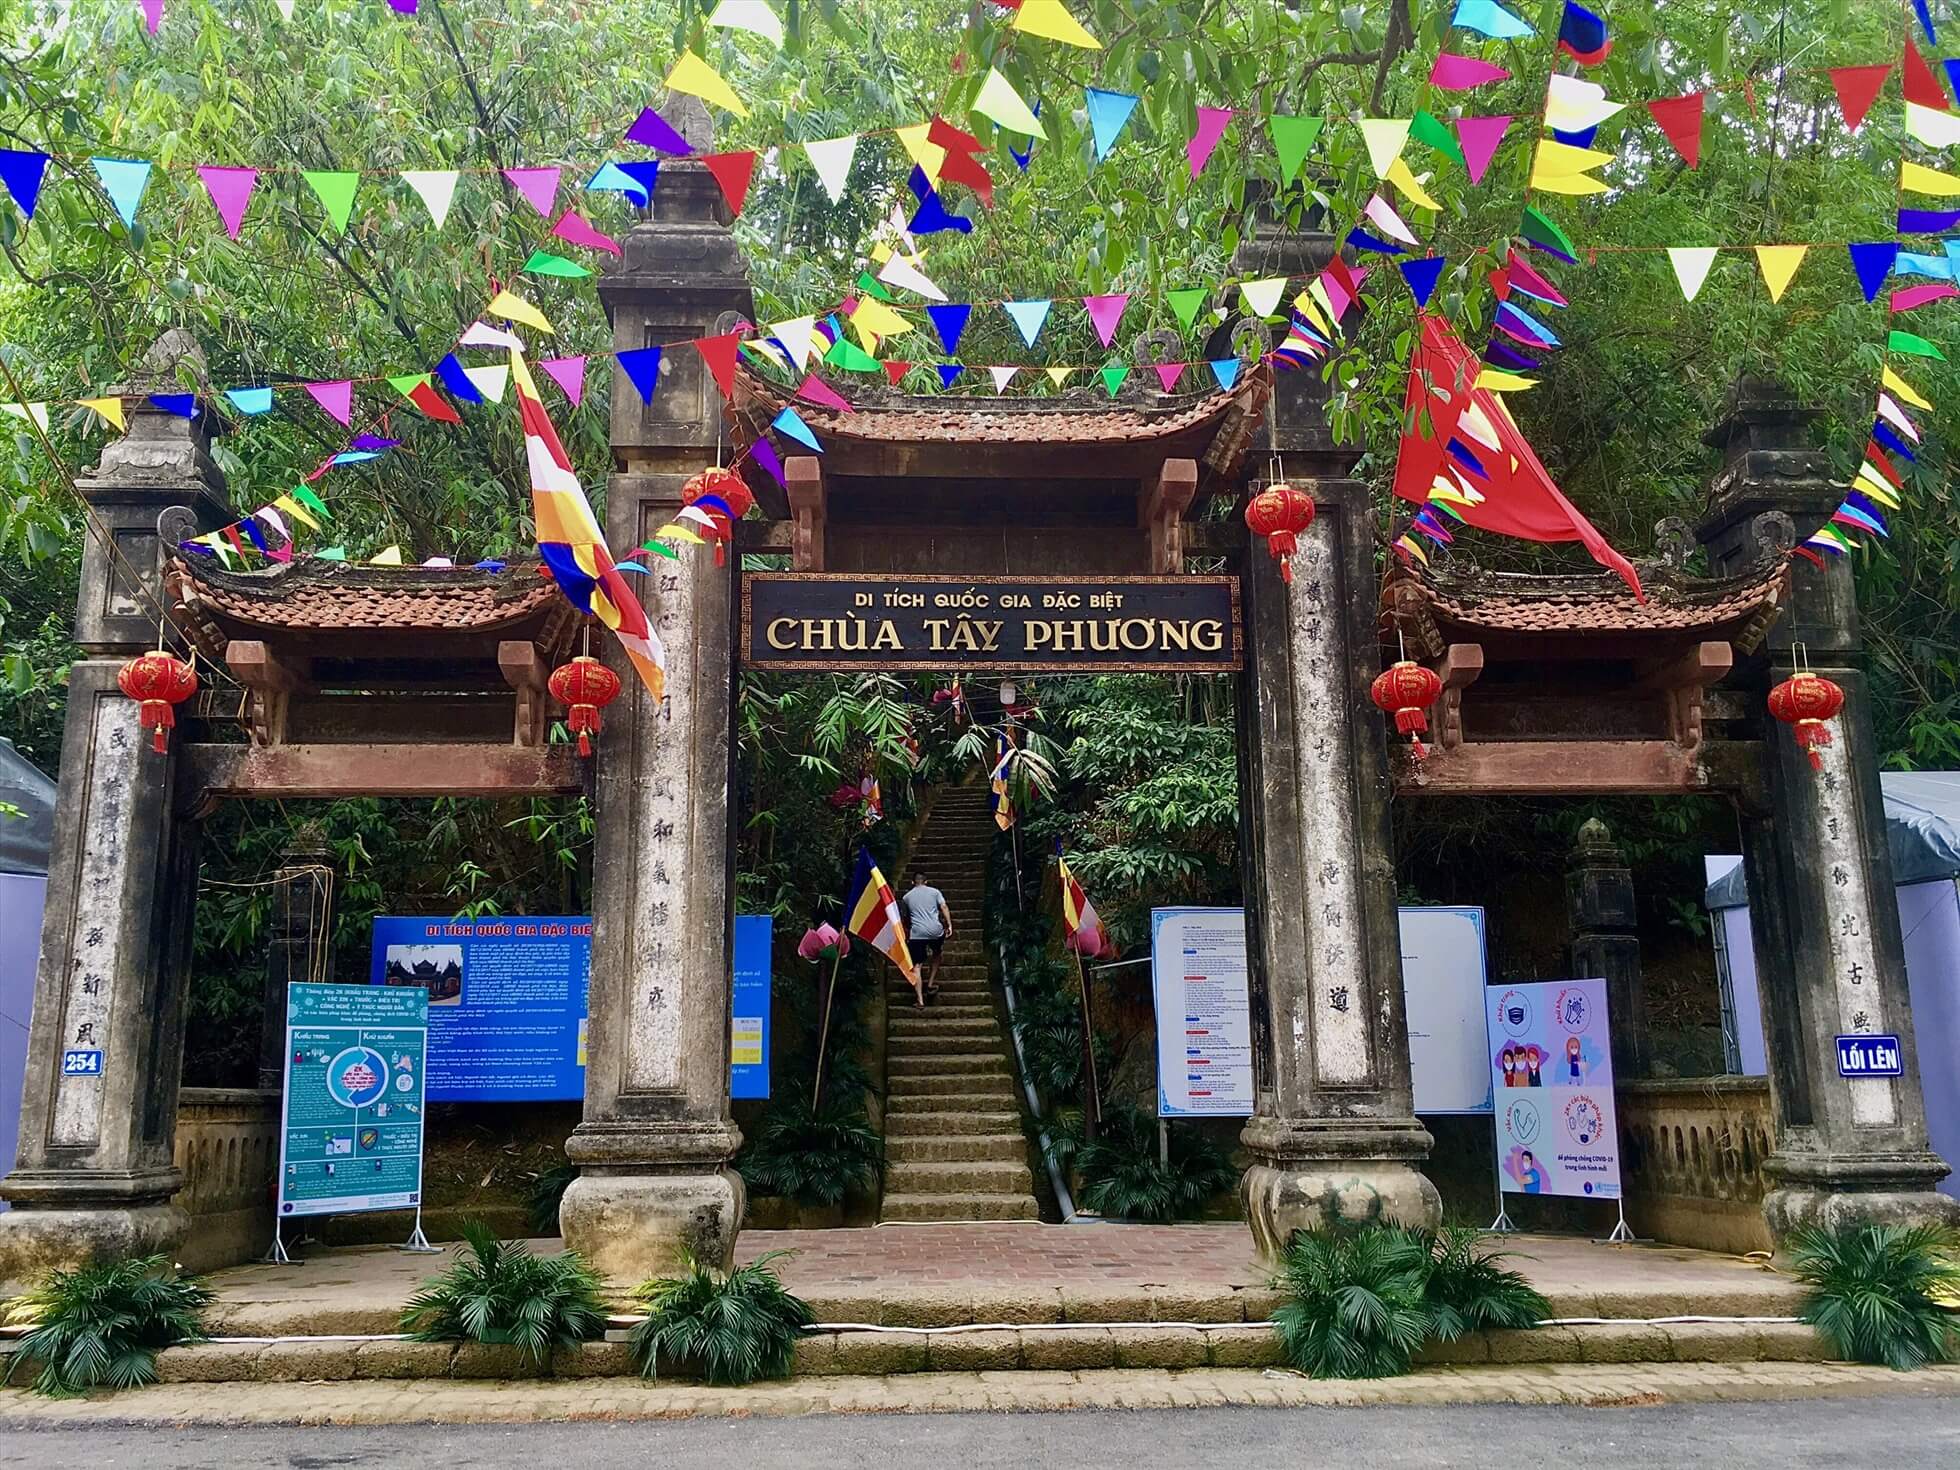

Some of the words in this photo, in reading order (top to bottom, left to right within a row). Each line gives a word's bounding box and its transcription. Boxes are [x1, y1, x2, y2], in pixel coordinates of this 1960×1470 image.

[855, 592, 873, 608] DI
[883, 588, 925, 608] TÍCH
[934, 587, 989, 609] QUỐC
[1000, 593, 1032, 608] GIA
[1042, 590, 1081, 612] ĐẶC
[1090, 590, 1124, 612] BIỆT
[767, 610, 904, 651] CHÙA
[923, 612, 1001, 652] TÂY
[1023, 617, 1225, 652] PHƯƠNG
[427, 925, 440, 936] DI
[444, 923, 473, 936] TÍCH
[476, 922, 512, 936] QUỐC
[515, 924, 538, 936] GIA
[541, 924, 567, 937] ĐẶC
[65, 1054, 97, 1071] 254
[1841, 1042, 1866, 1070] LỐI
[1868, 1045, 1898, 1070] LÊN
